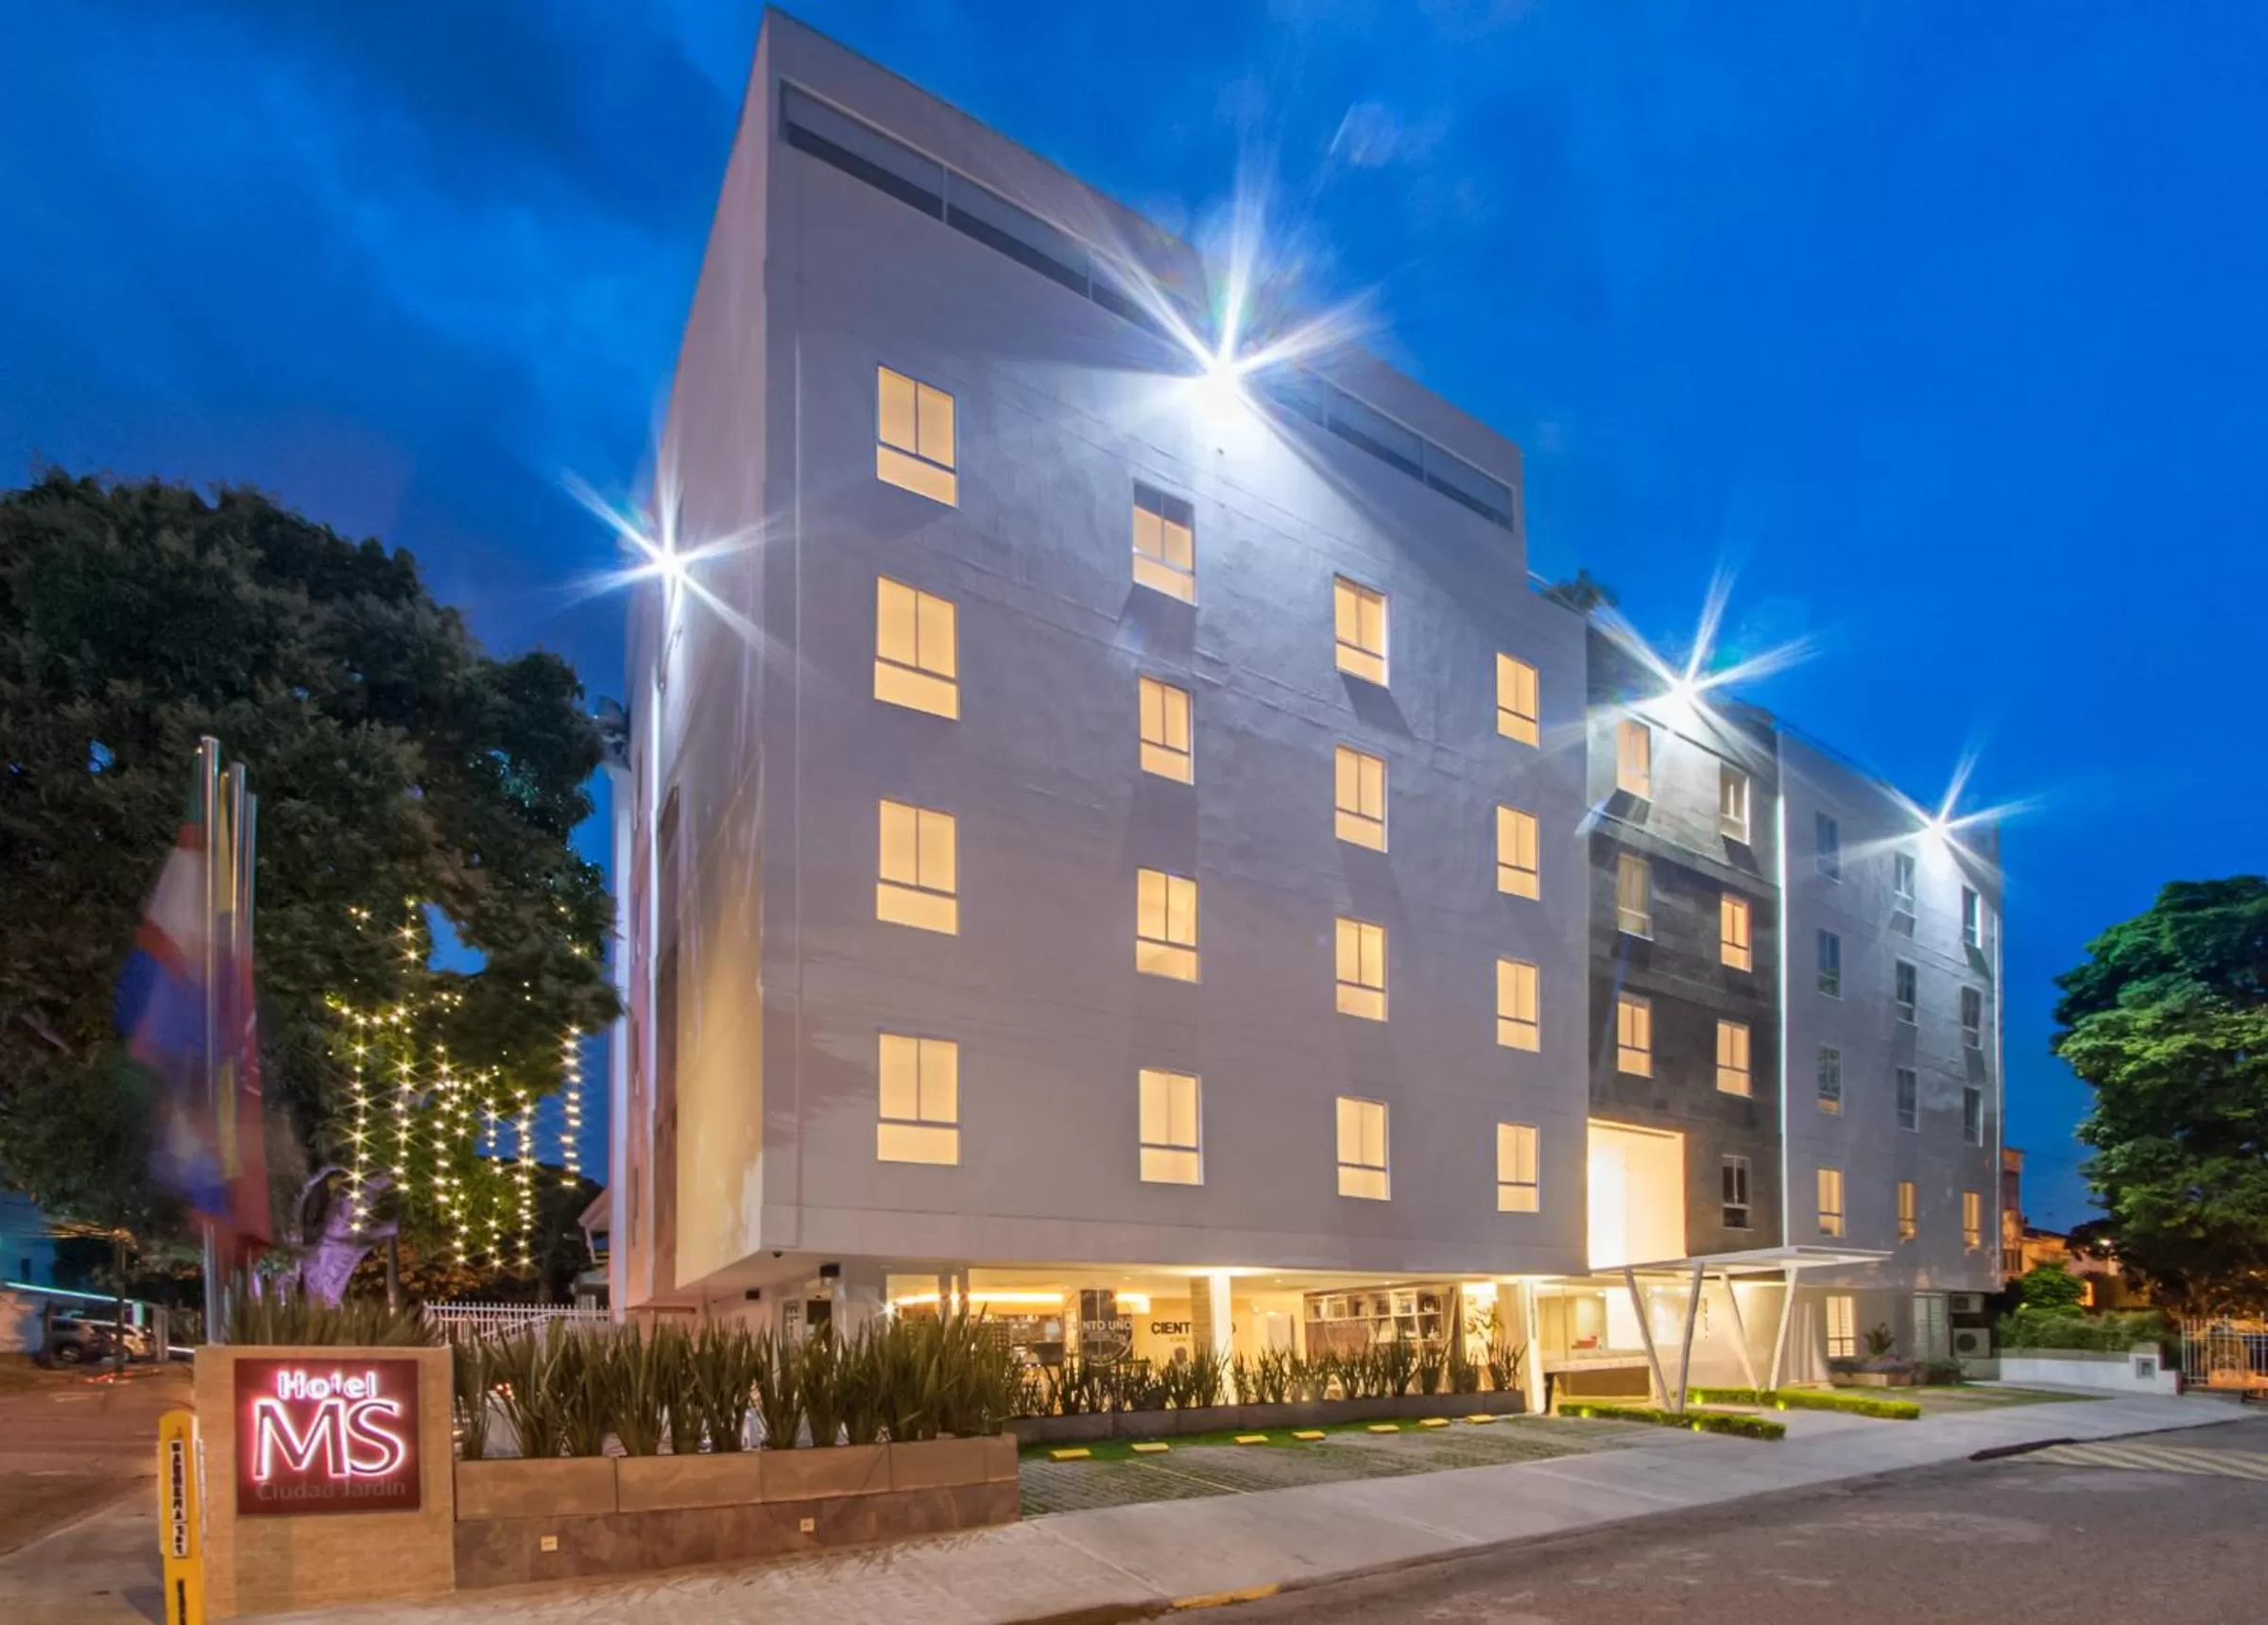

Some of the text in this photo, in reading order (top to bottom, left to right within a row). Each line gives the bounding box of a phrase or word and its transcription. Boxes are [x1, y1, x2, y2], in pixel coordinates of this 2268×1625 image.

[1108, 1320, 1132, 1331] UNO
[1150, 1322, 1192, 1335] CIENT
[278, 1371, 377, 1399] Hotel
[253, 1396, 405, 1480] MS
[257, 1480, 335, 1500] Ciudad
